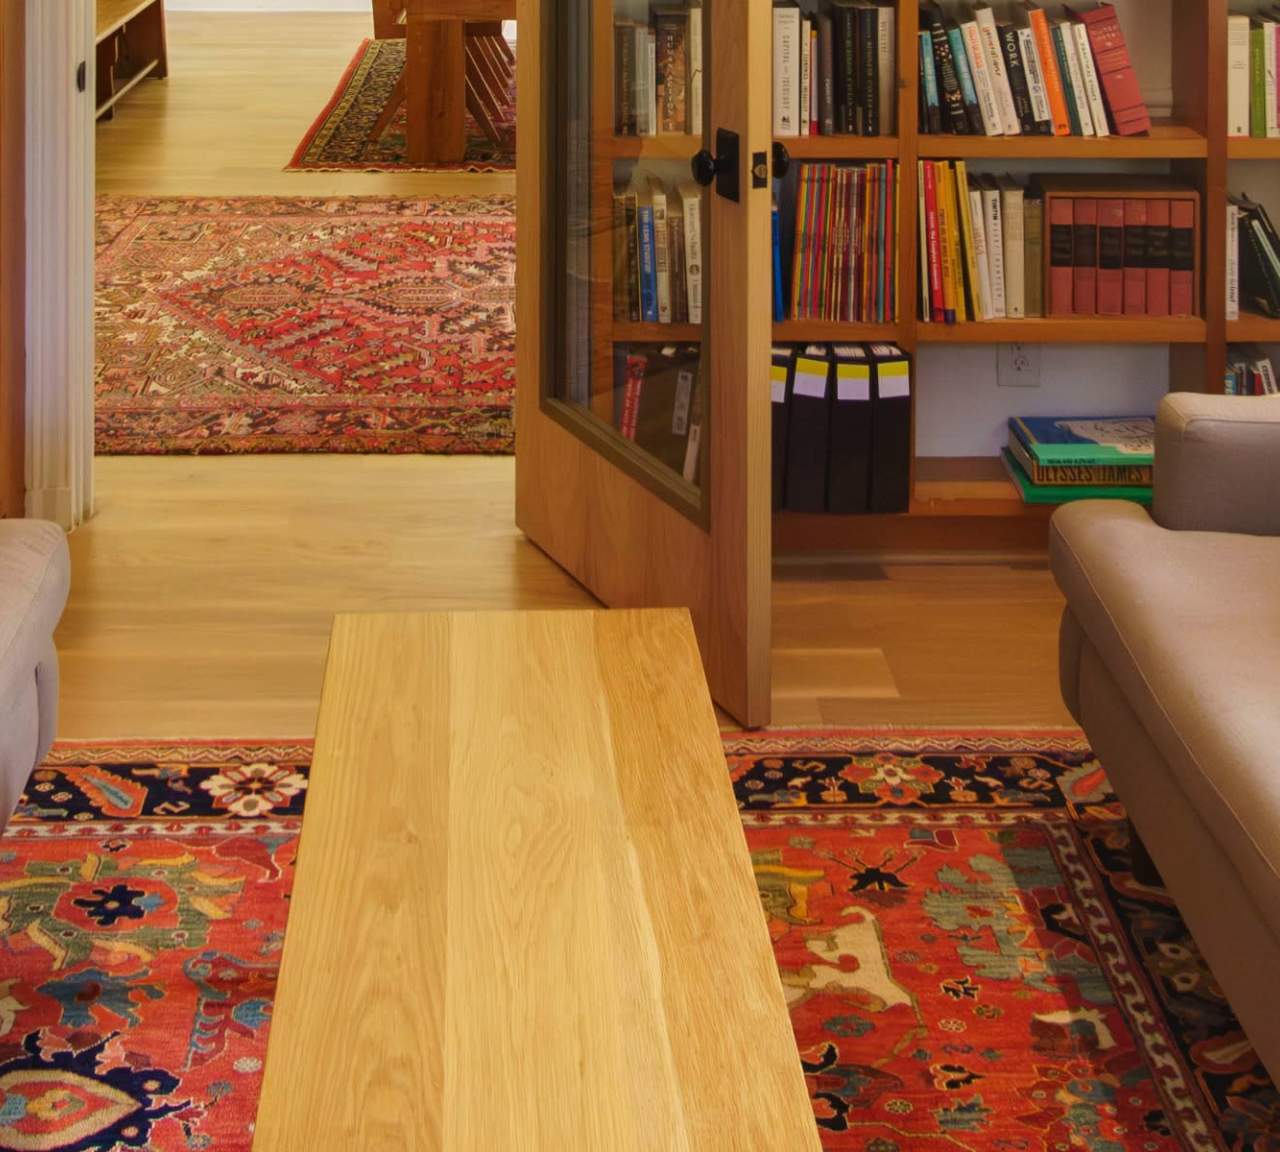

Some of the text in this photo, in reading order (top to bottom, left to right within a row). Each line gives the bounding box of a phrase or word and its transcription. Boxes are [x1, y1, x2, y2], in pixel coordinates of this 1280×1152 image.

[1004, 31, 1019, 68] WORK
[991, 198, 999, 221] TINTIN
[1036, 465, 1093, 483] ULYSSES
